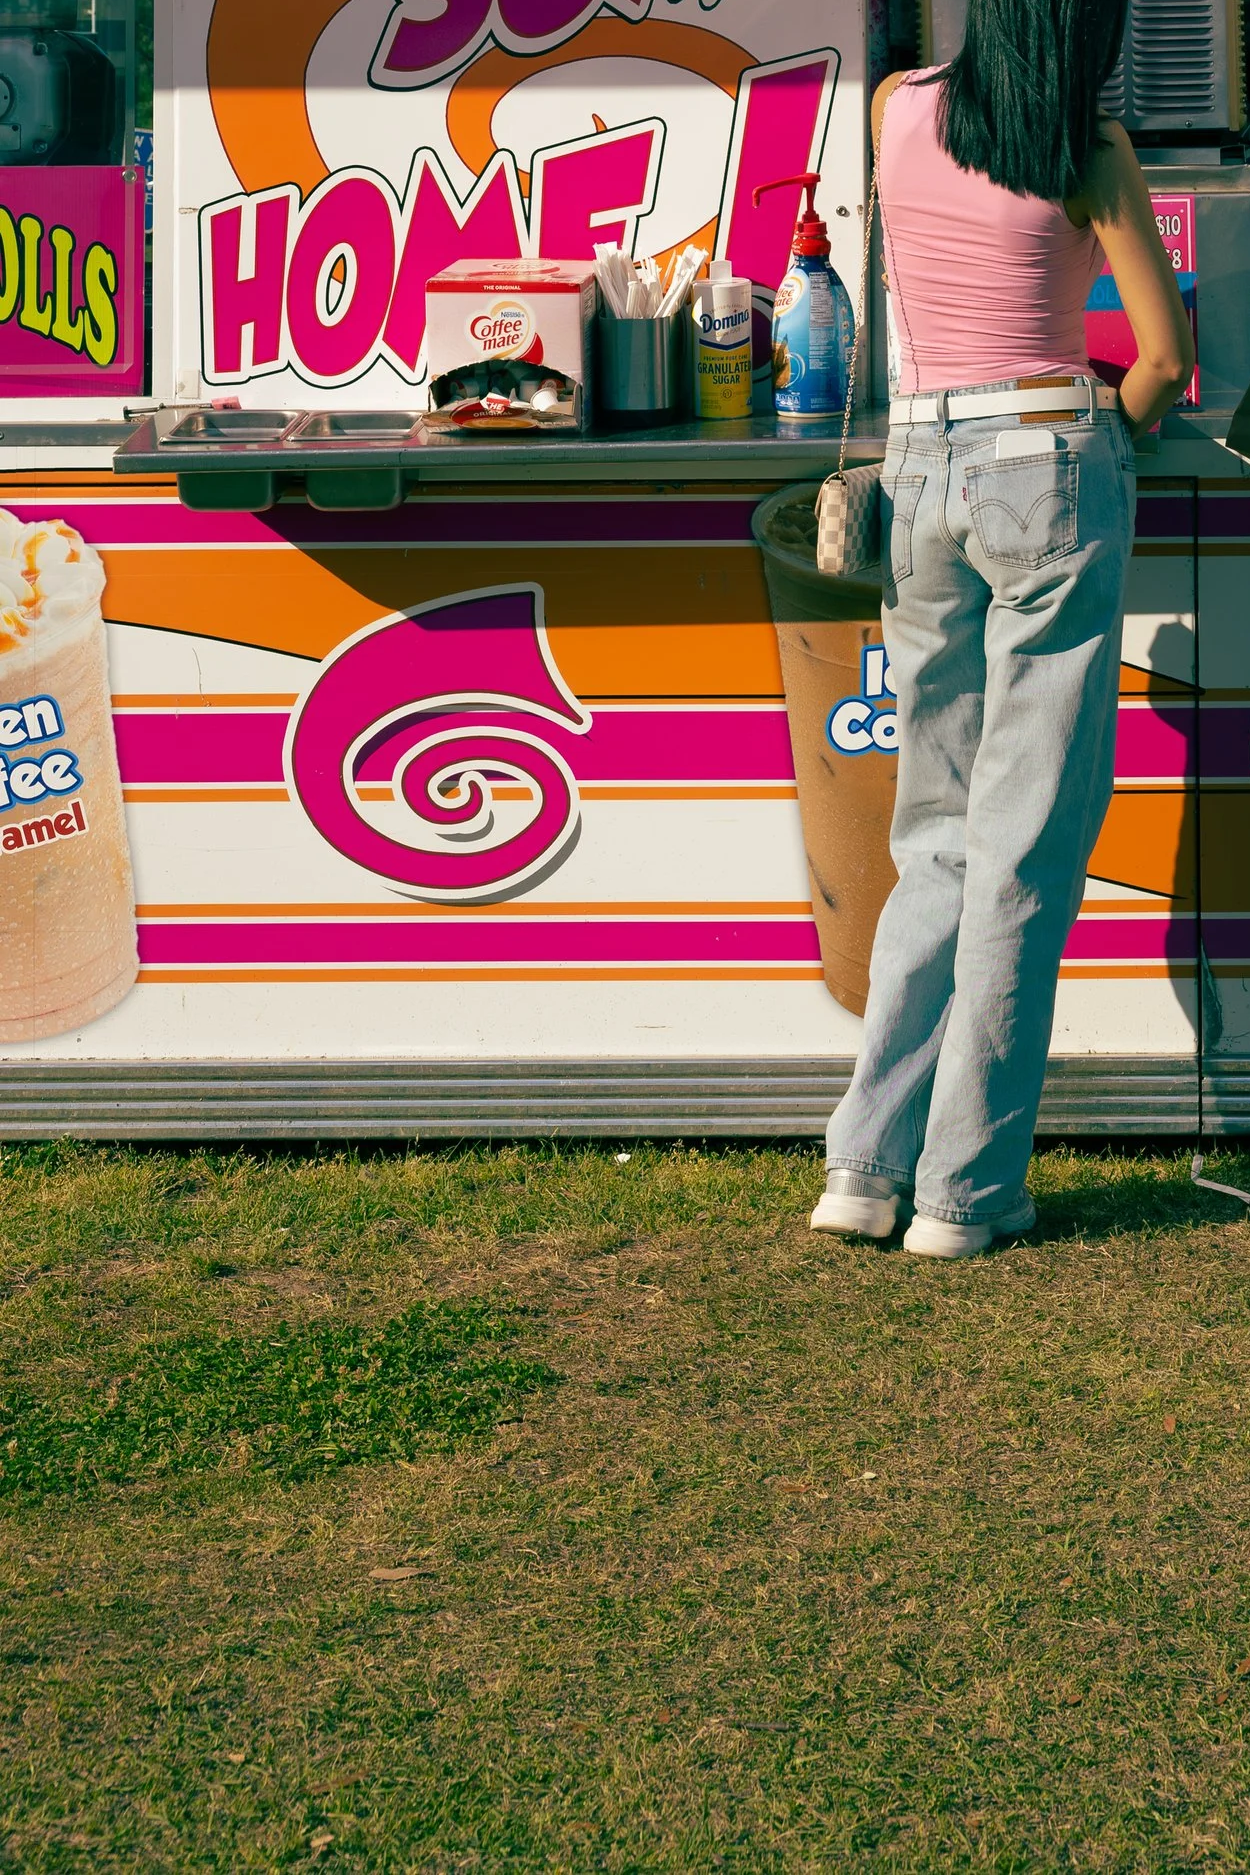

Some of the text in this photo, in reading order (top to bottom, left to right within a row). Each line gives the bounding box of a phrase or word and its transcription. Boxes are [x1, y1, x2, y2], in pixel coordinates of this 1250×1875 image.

[1154, 214, 1182, 236] $10
[470, 315, 523, 340] Coffee
[700, 308, 750, 334] Domino
[482, 332, 520, 351] mate
[712, 375, 741, 385] SUGAR
[2, 800, 87, 853] amel
